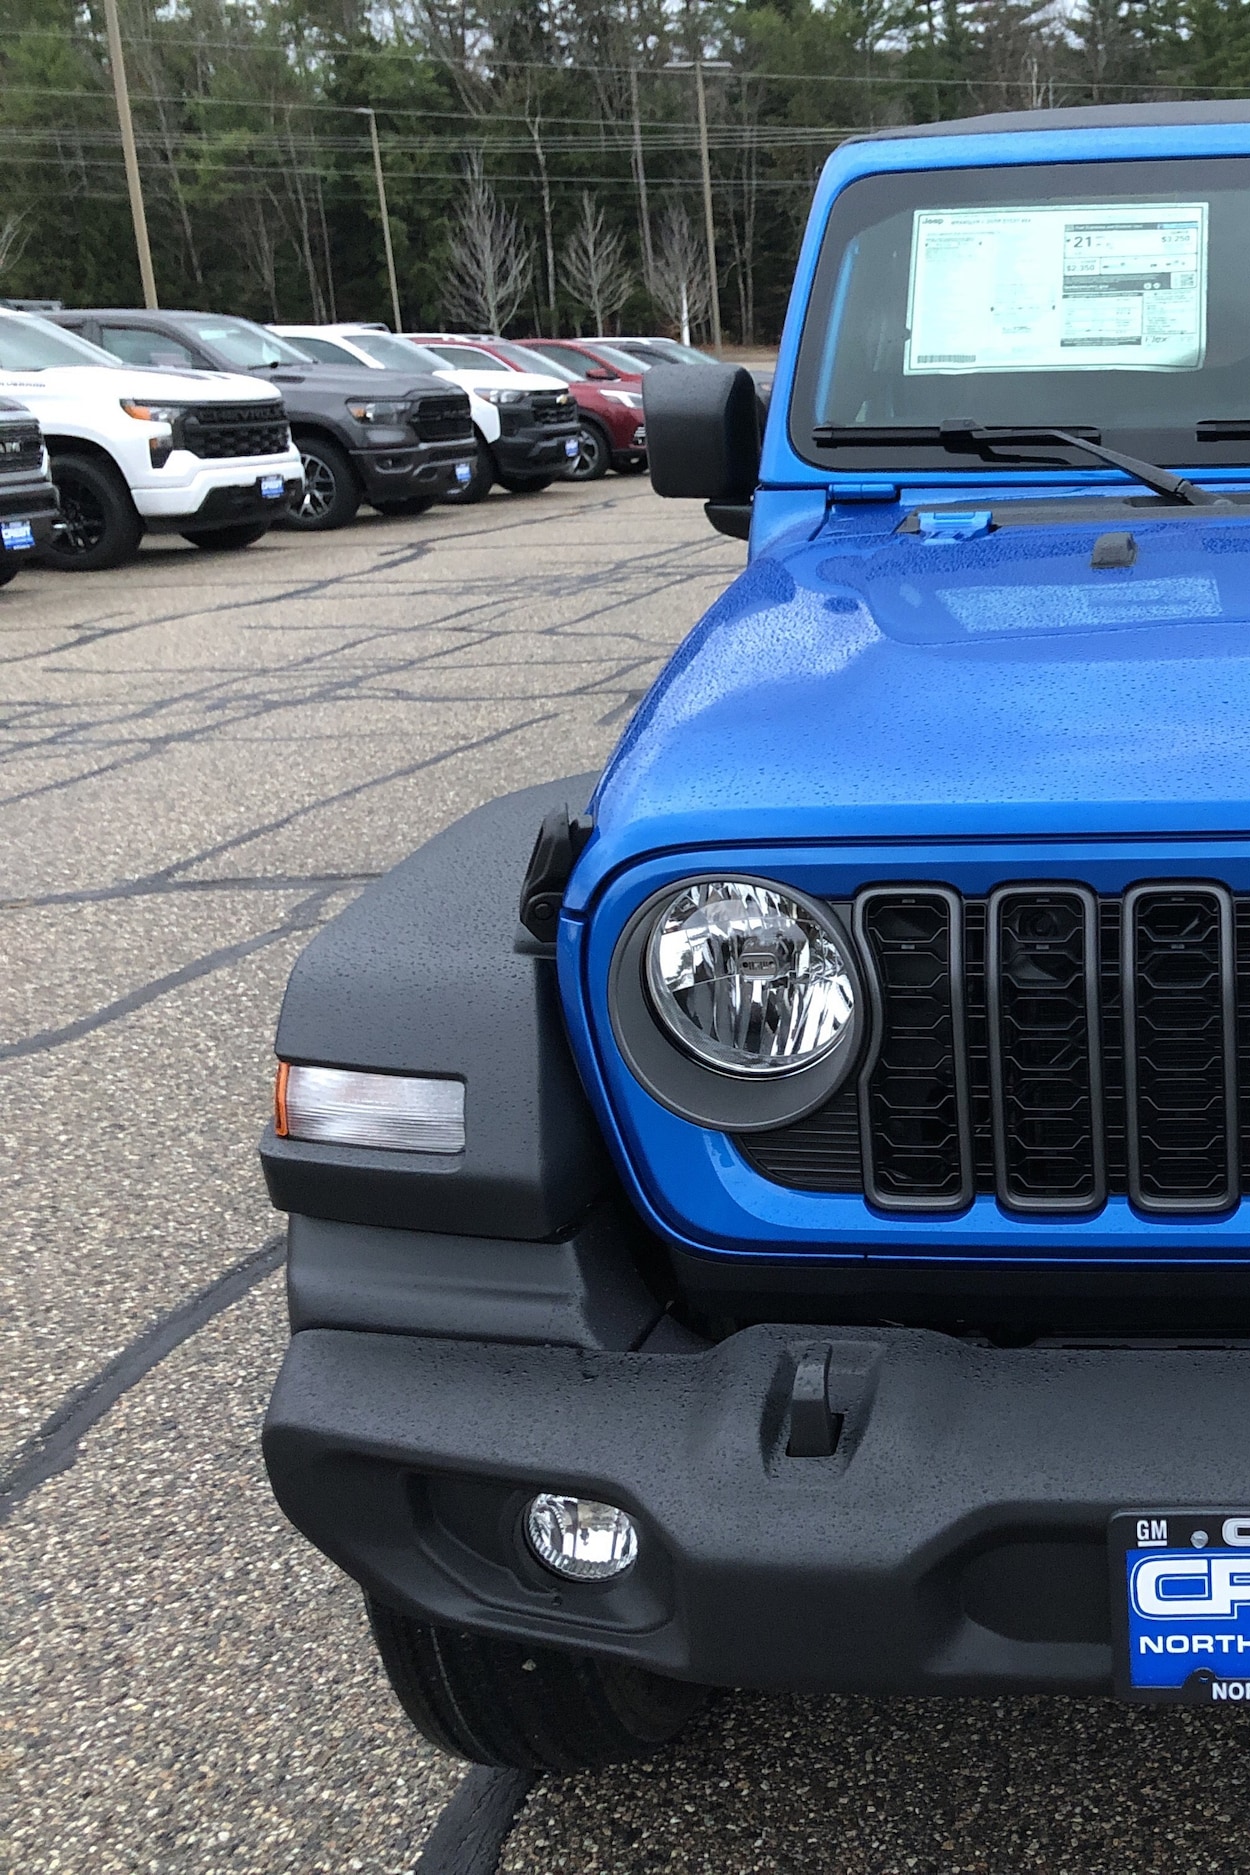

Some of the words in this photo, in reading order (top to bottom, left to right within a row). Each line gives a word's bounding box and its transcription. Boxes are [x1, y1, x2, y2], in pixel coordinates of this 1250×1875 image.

[922, 217, 944, 225] Jeep
[1073, 236, 1092, 247] 21
[1137, 1520, 1167, 1540] GM
